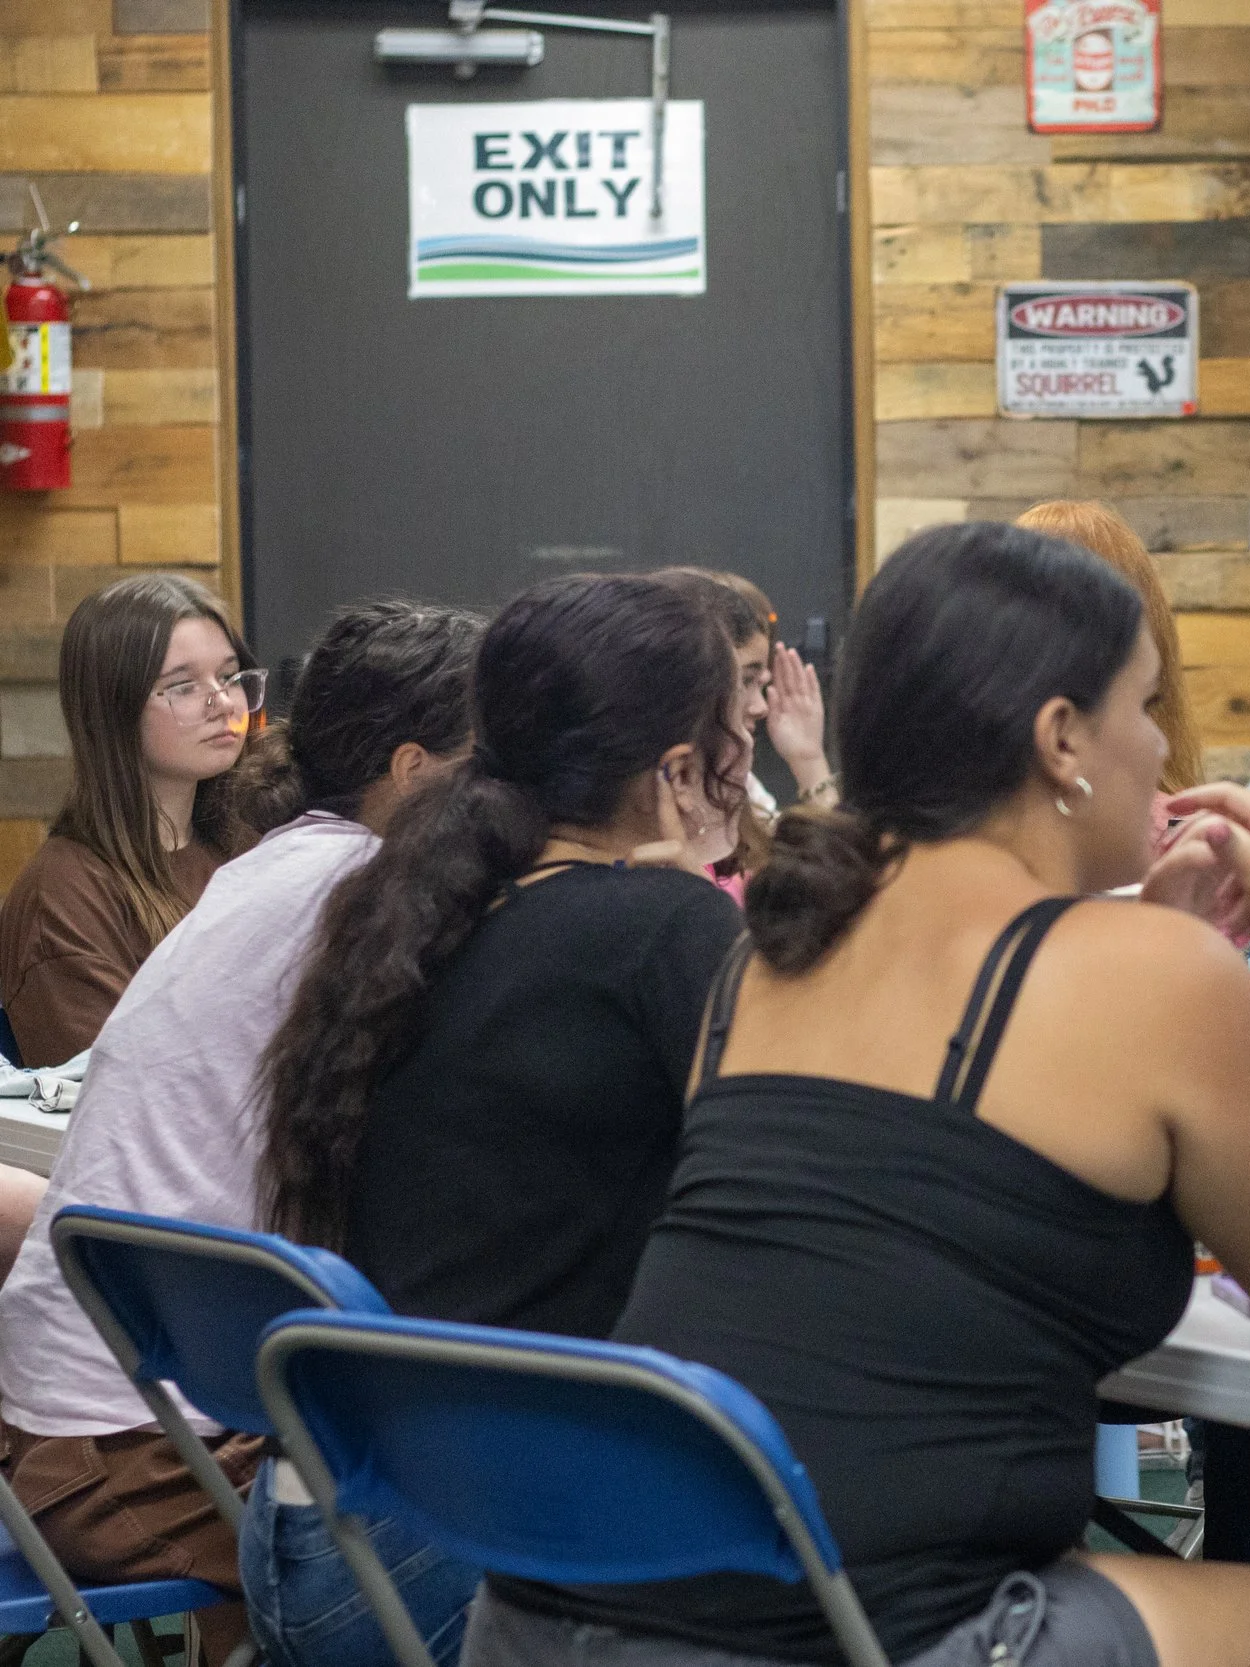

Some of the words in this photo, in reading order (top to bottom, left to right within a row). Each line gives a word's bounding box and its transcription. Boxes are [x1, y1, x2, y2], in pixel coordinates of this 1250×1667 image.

[472, 130, 641, 170] EXIT
[472, 177, 642, 220] ONLY
[1024, 303, 1170, 328] WARNING
[1016, 372, 1123, 397] SQUIRREL
